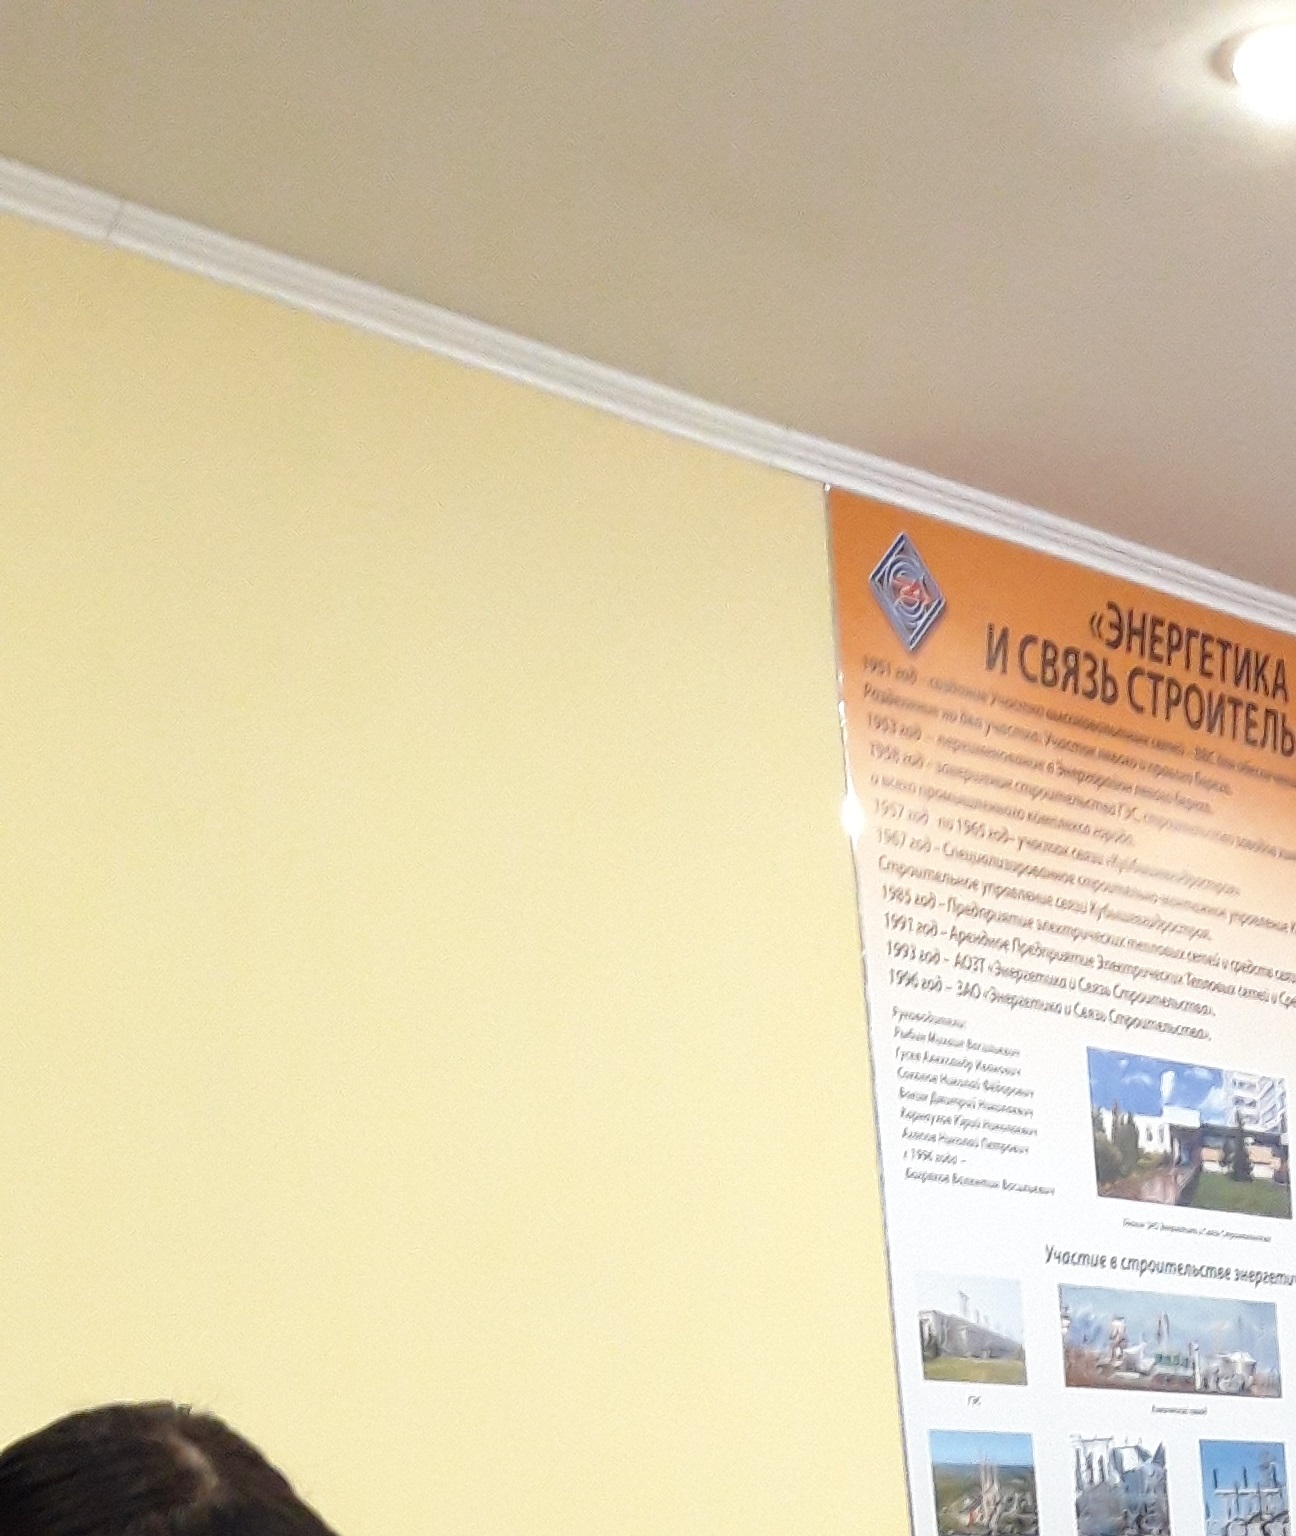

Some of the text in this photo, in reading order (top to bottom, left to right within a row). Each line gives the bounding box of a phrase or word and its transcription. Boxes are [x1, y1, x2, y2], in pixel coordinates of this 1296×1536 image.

[985, 626, 1009, 673] И
[1017, 634, 1119, 706] СВЯЗЬ
[1089, 600, 1289, 703] «ЭНЕРГЕТИКА
[918, 950, 941, 965] год
[920, 975, 943, 992] год
[1045, 1246, 1106, 1268] Участие
[1120, 1257, 1231, 1280] строительстве
